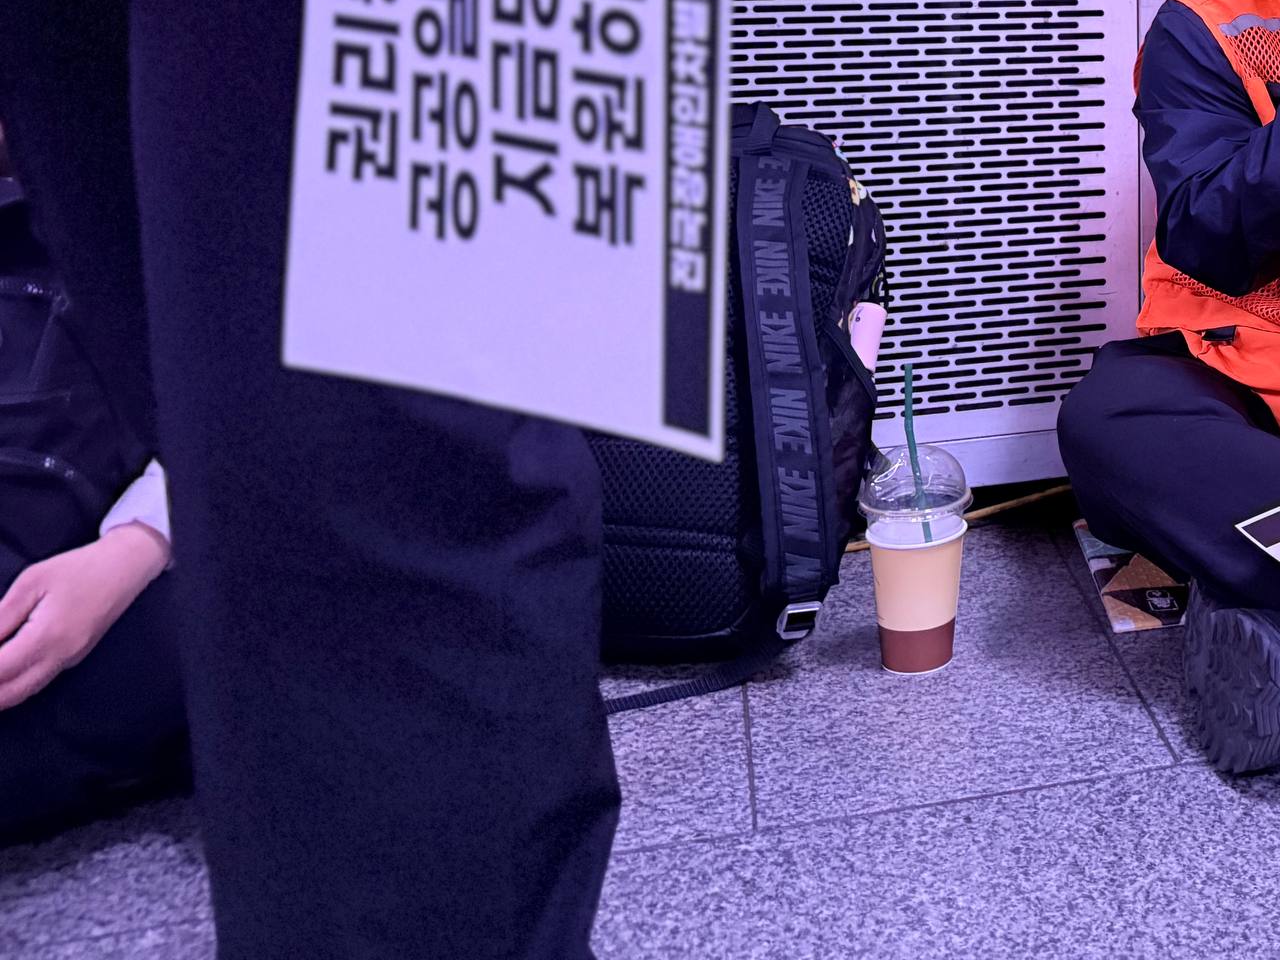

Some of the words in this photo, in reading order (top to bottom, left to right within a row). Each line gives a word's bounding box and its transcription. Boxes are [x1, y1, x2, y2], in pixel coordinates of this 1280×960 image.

[752, 177, 787, 227] NIKE
[753, 240, 792, 297] NIKE
[759, 310, 803, 374] NIKE
[769, 387, 813, 455] NIKE
[777, 466, 820, 541] NIKE
